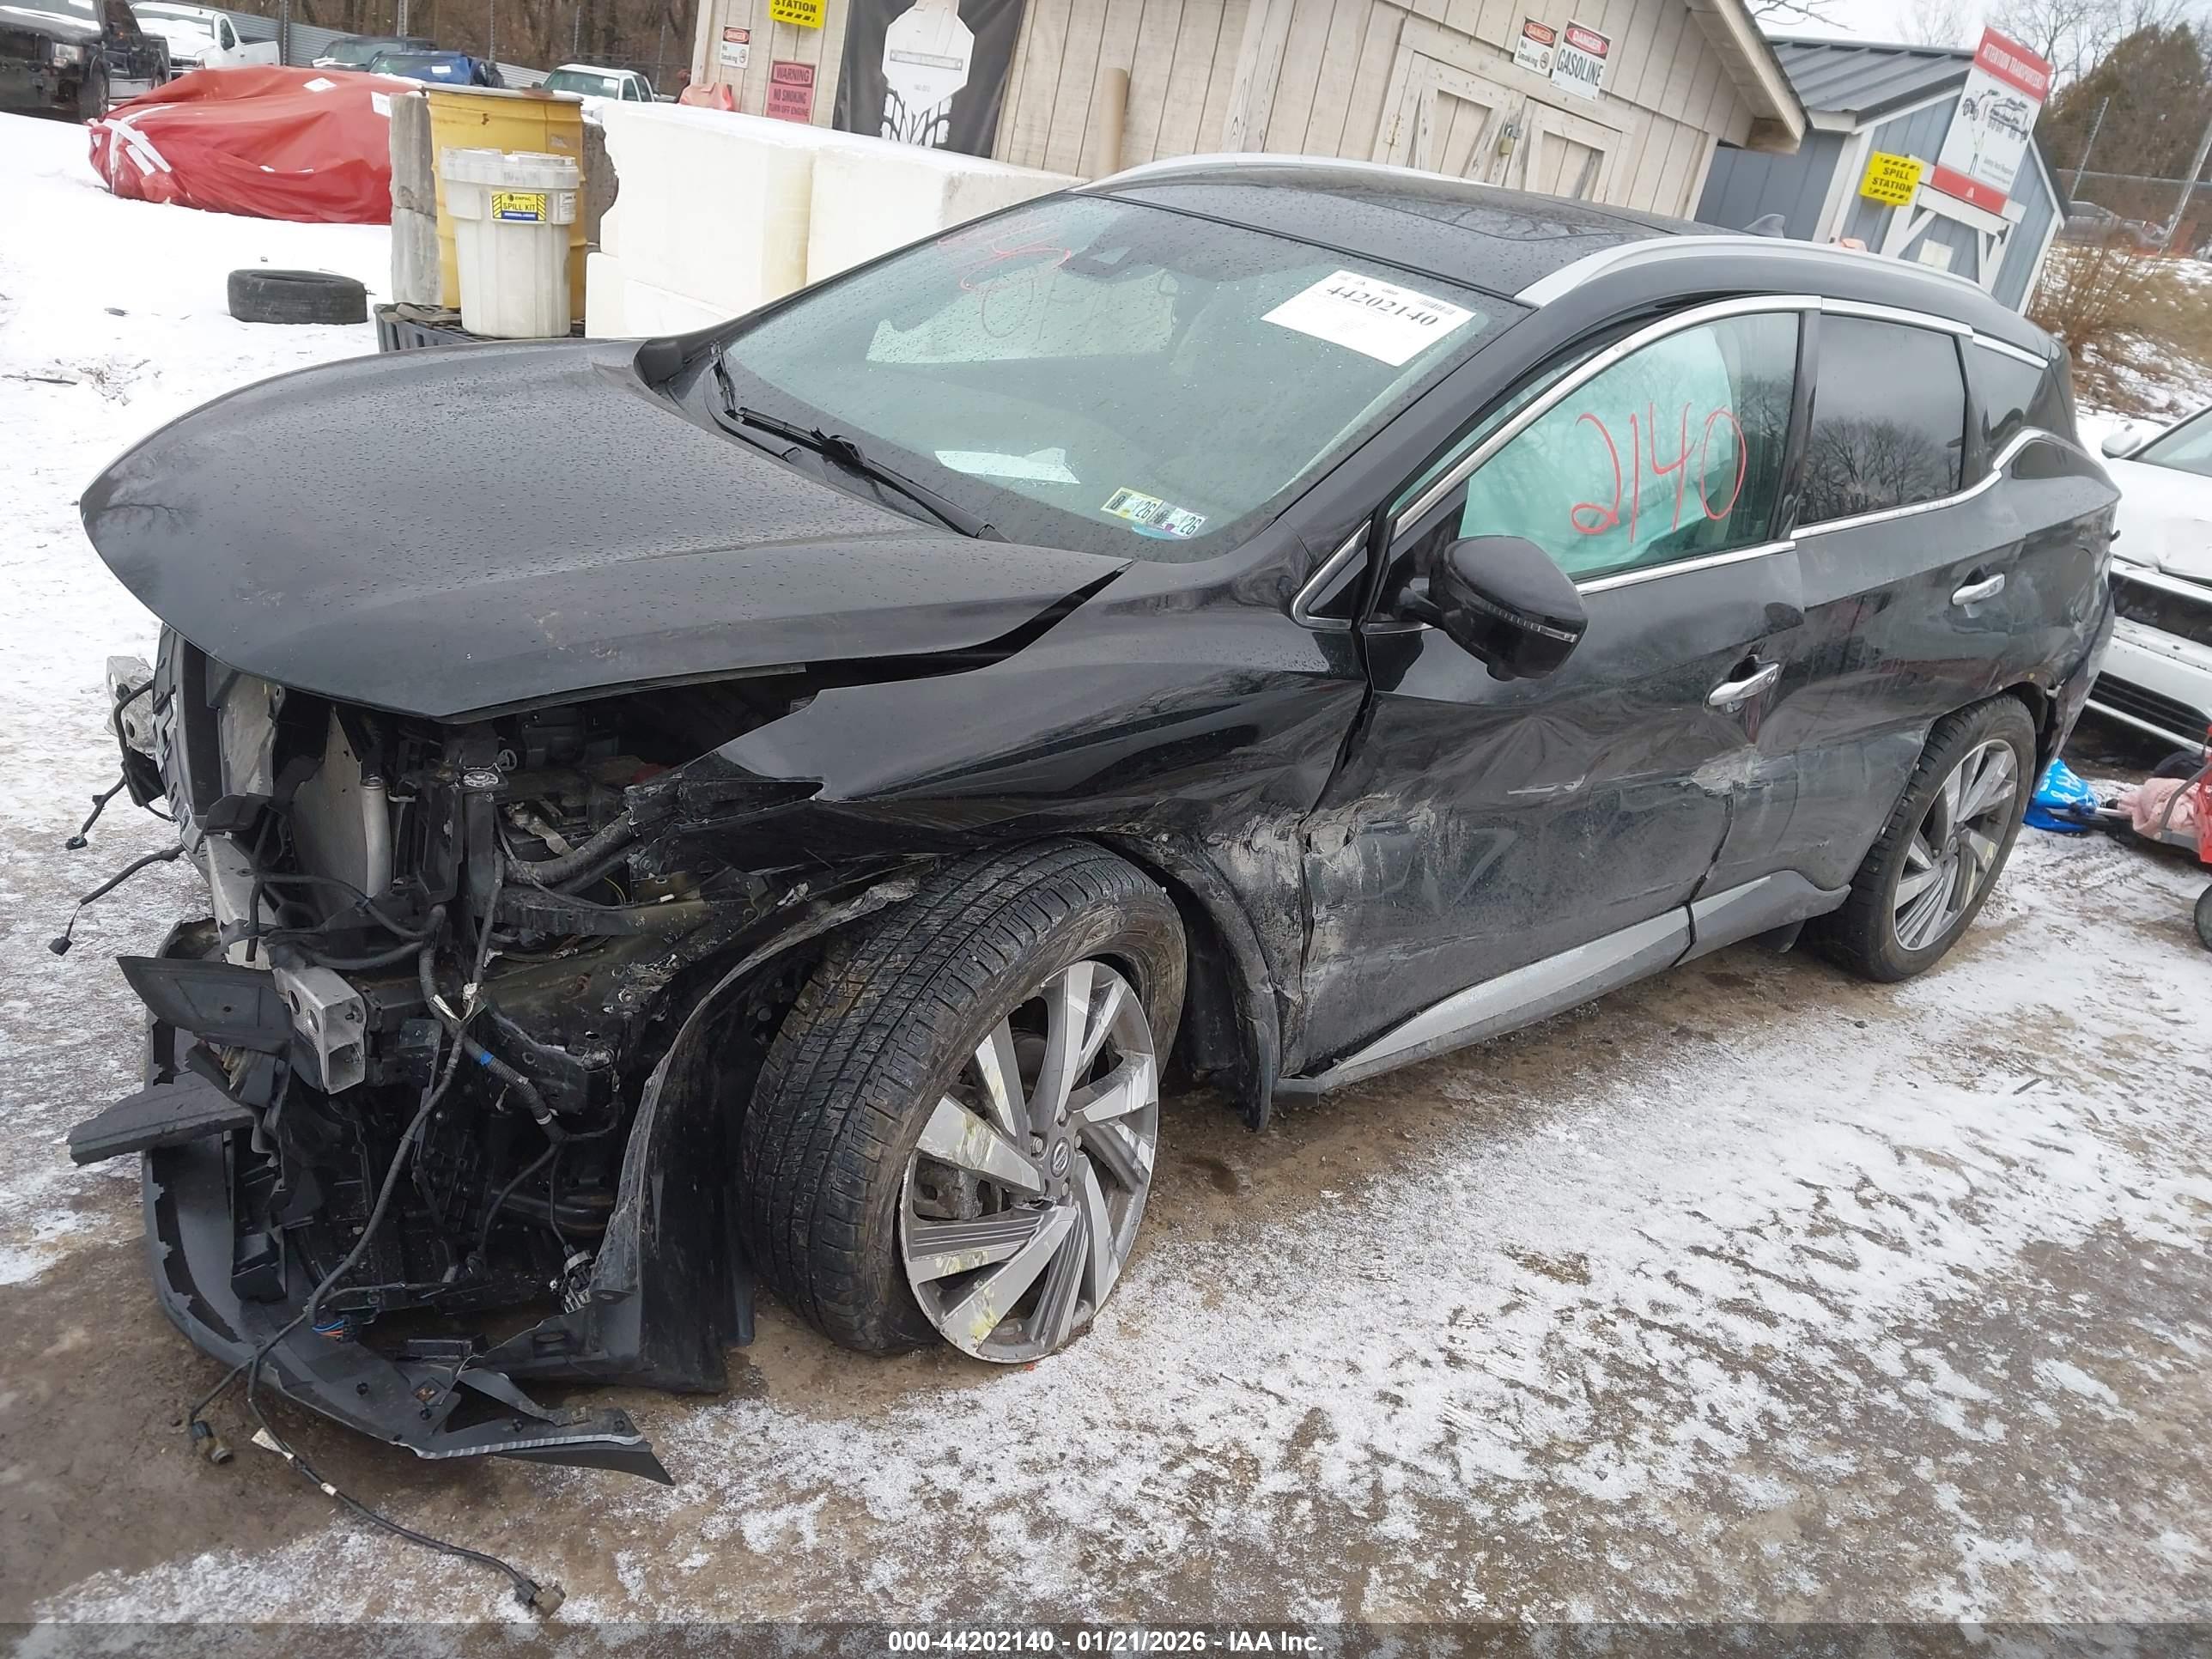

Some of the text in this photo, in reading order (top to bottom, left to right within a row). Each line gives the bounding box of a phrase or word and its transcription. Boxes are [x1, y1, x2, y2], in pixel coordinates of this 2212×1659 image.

[775, 0, 817, 13] STATION
[776, 66, 810, 82] WARNING
[1557, 48, 1604, 87] GASOLINE
[1883, 167, 1909, 180] SPILL
[1872, 177, 1913, 193] STATION
[1326, 286, 1439, 326] 44202140
[1571, 399, 1747, 543] 2140
